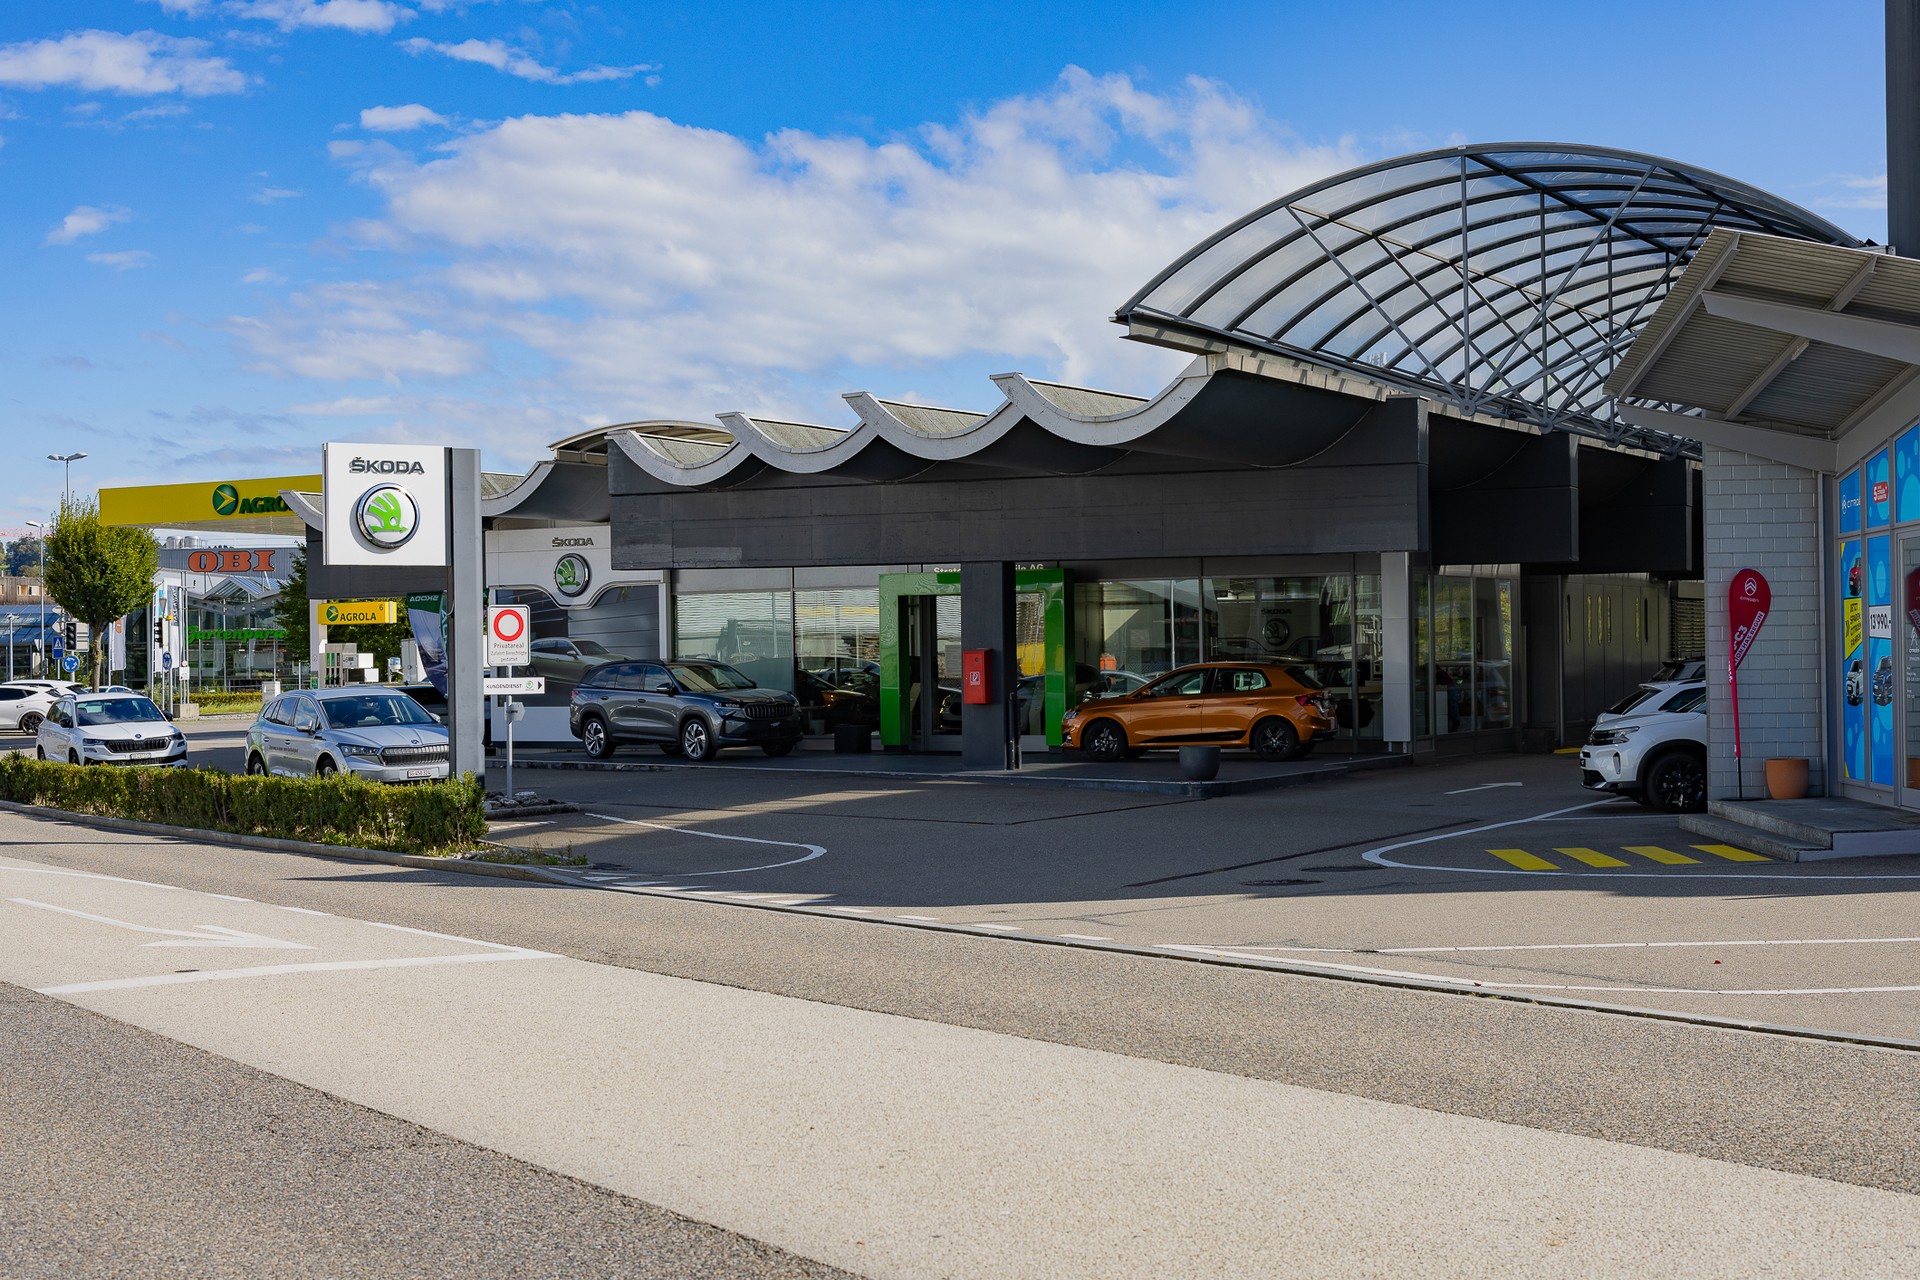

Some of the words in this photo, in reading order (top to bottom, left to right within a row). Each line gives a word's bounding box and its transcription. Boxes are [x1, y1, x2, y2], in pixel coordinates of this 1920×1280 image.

[351, 457, 425, 474] ŠKODA
[239, 496, 293, 514] AGRO
[552, 537, 594, 547] ŠKODA
[188, 550, 276, 572] OBI
[340, 612, 377, 622] AGROLA
[187, 625, 289, 644] Gartenpara
